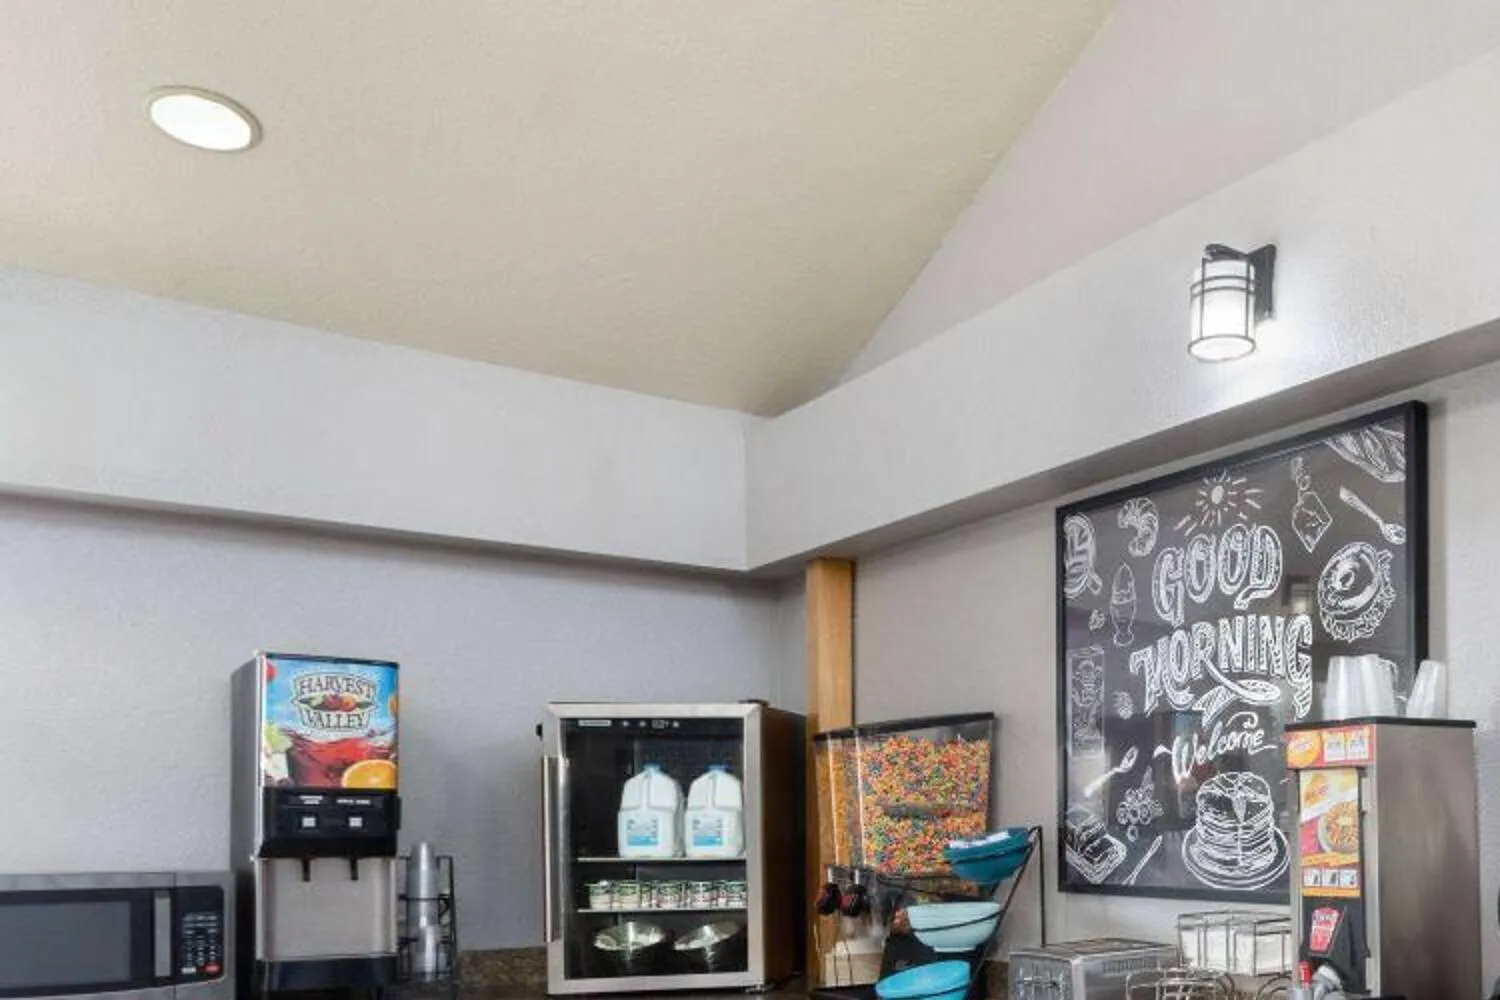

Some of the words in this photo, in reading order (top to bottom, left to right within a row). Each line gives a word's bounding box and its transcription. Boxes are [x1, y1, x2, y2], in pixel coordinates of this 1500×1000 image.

[1151, 523, 1284, 627] GOOD
[298, 675, 375, 698] HARVEST
[1129, 614, 1313, 721] MORNING
[301, 711, 367, 730] VALLEY
[1153, 712, 1278, 785] Welcome
